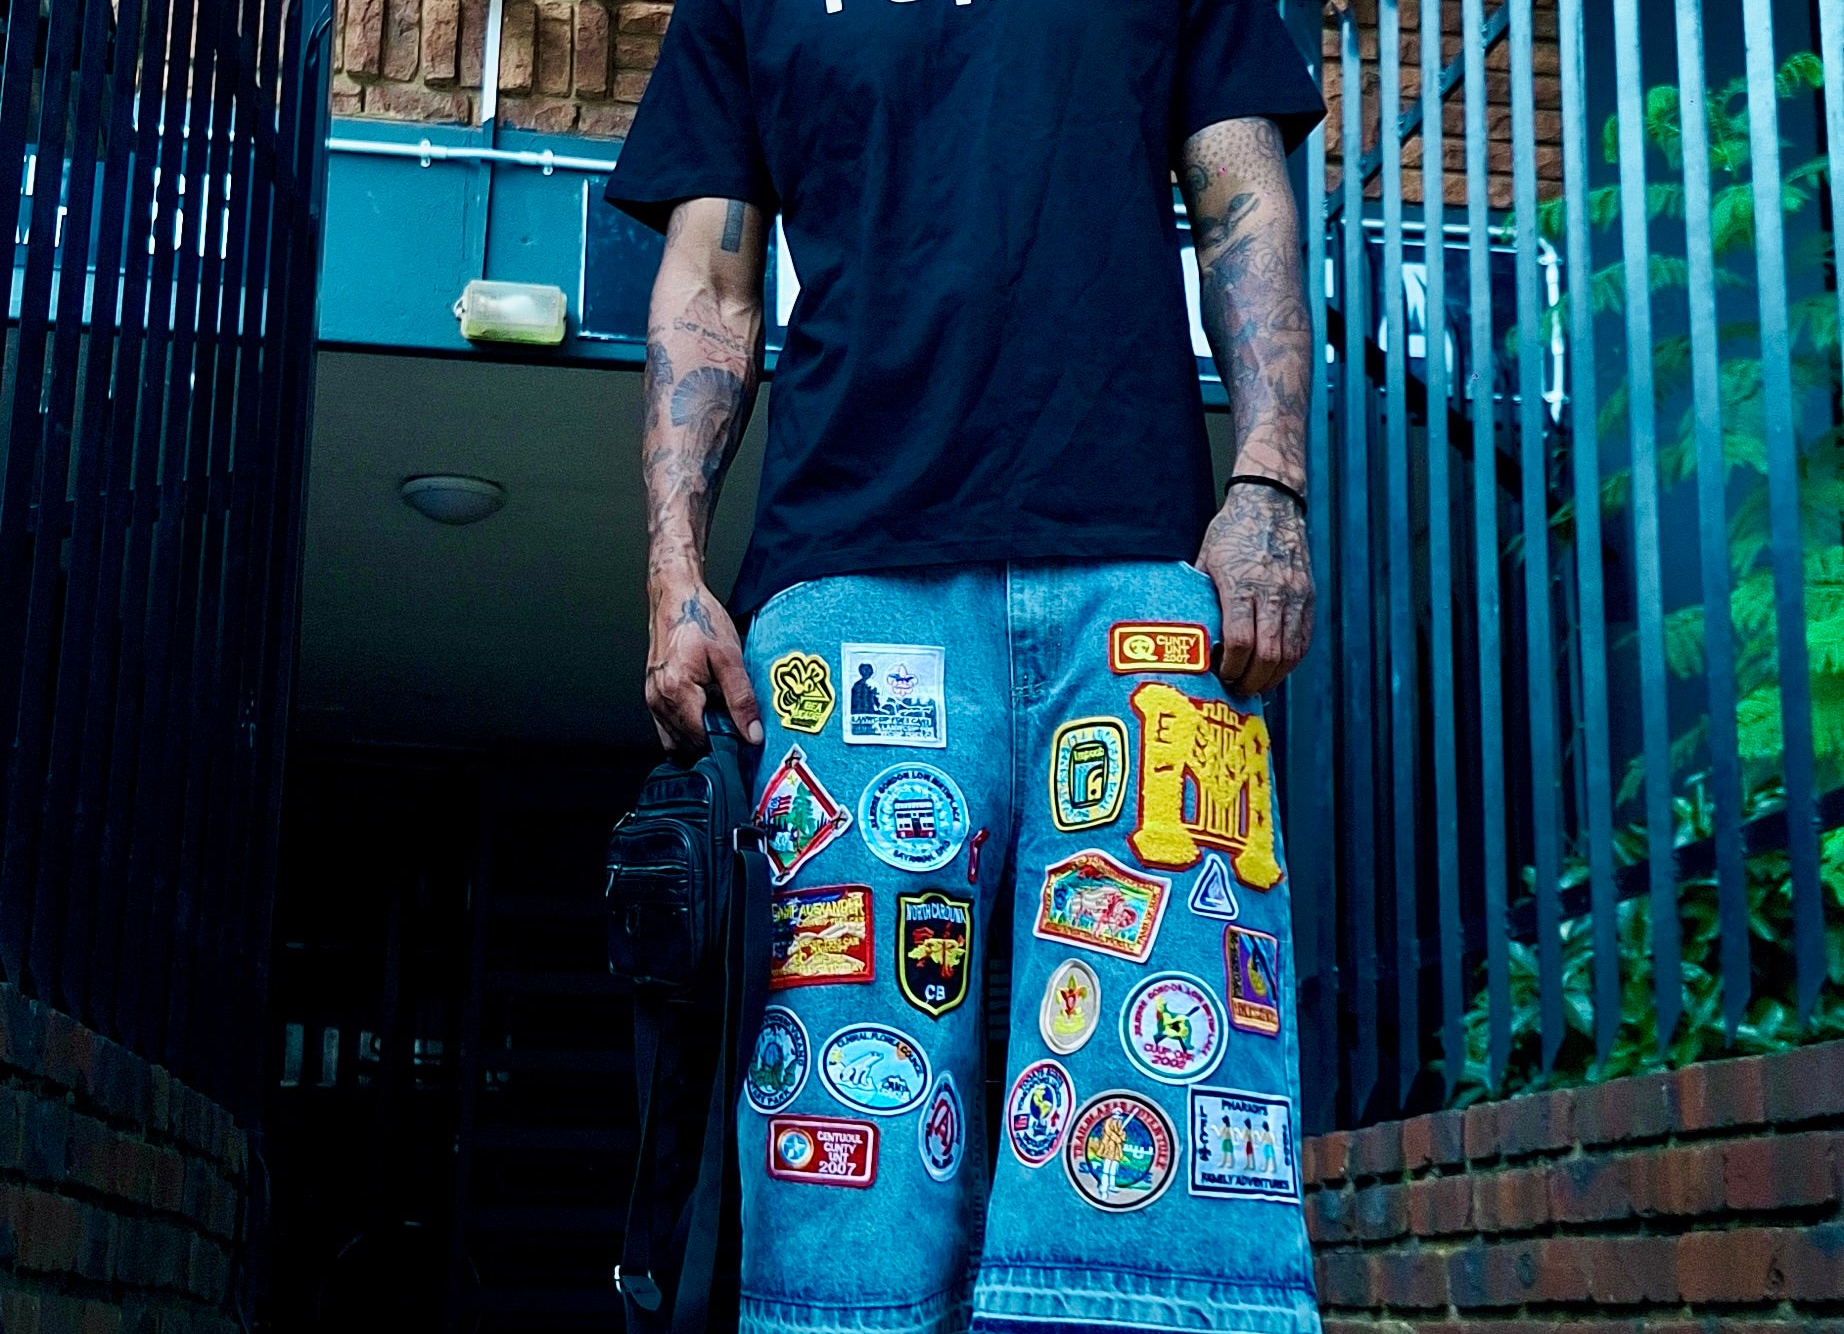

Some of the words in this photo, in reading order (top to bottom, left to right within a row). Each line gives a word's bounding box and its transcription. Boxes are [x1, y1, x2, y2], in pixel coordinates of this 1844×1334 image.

[1163, 654, 1190, 665] 2007
[906, 903, 931, 921] NORTH
[924, 984, 946, 1001] CB
[819, 1161, 857, 1176] 2007
